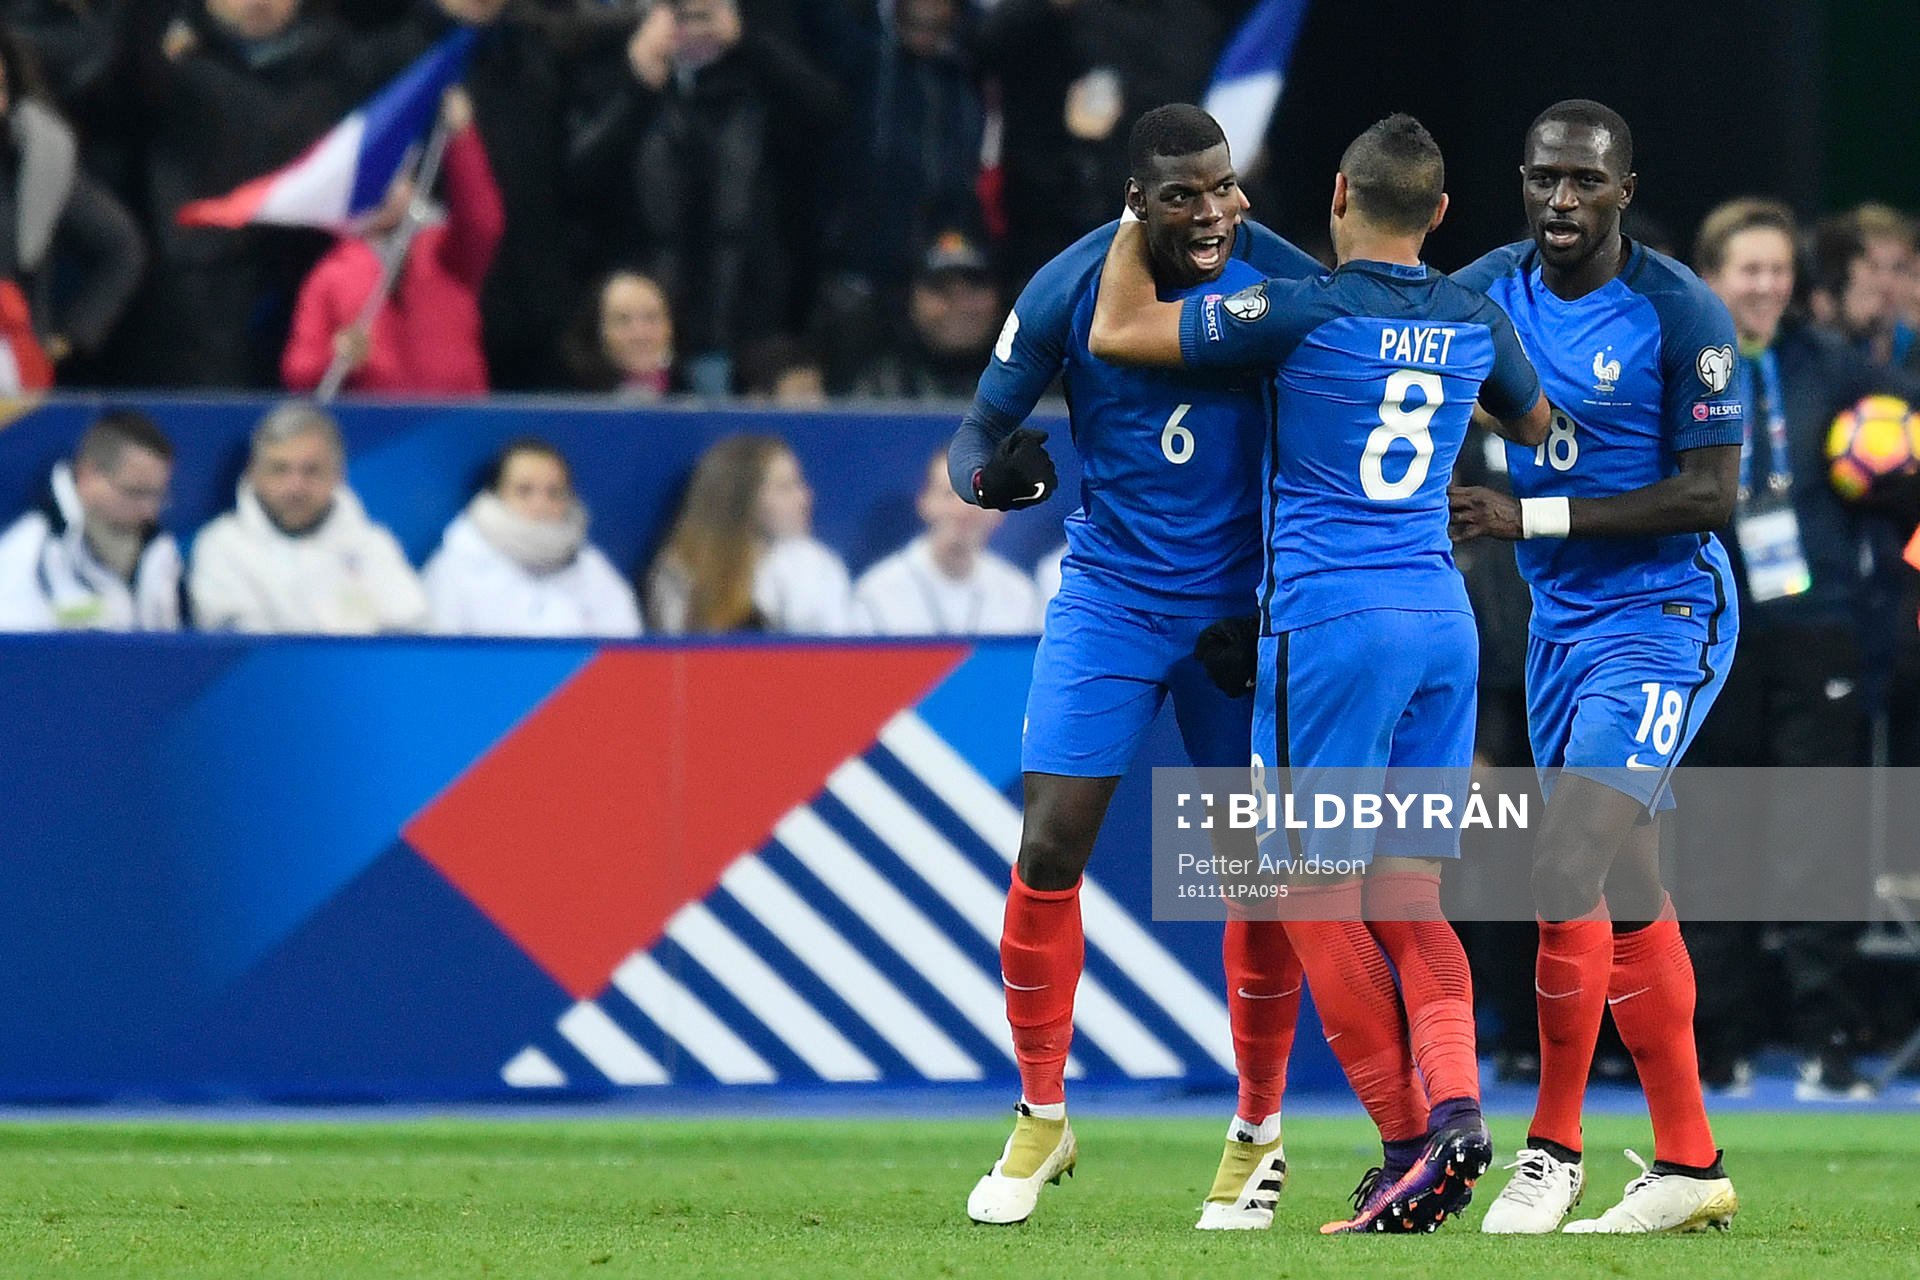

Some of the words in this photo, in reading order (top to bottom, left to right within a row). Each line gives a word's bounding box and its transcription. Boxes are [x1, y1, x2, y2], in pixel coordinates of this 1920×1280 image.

[1380, 326, 1456, 365] PAYET
[1161, 403, 1195, 464] 6
[1360, 369, 1444, 500] 8
[1709, 404, 1742, 416] RESPECT
[1635, 682, 1683, 755] 18
